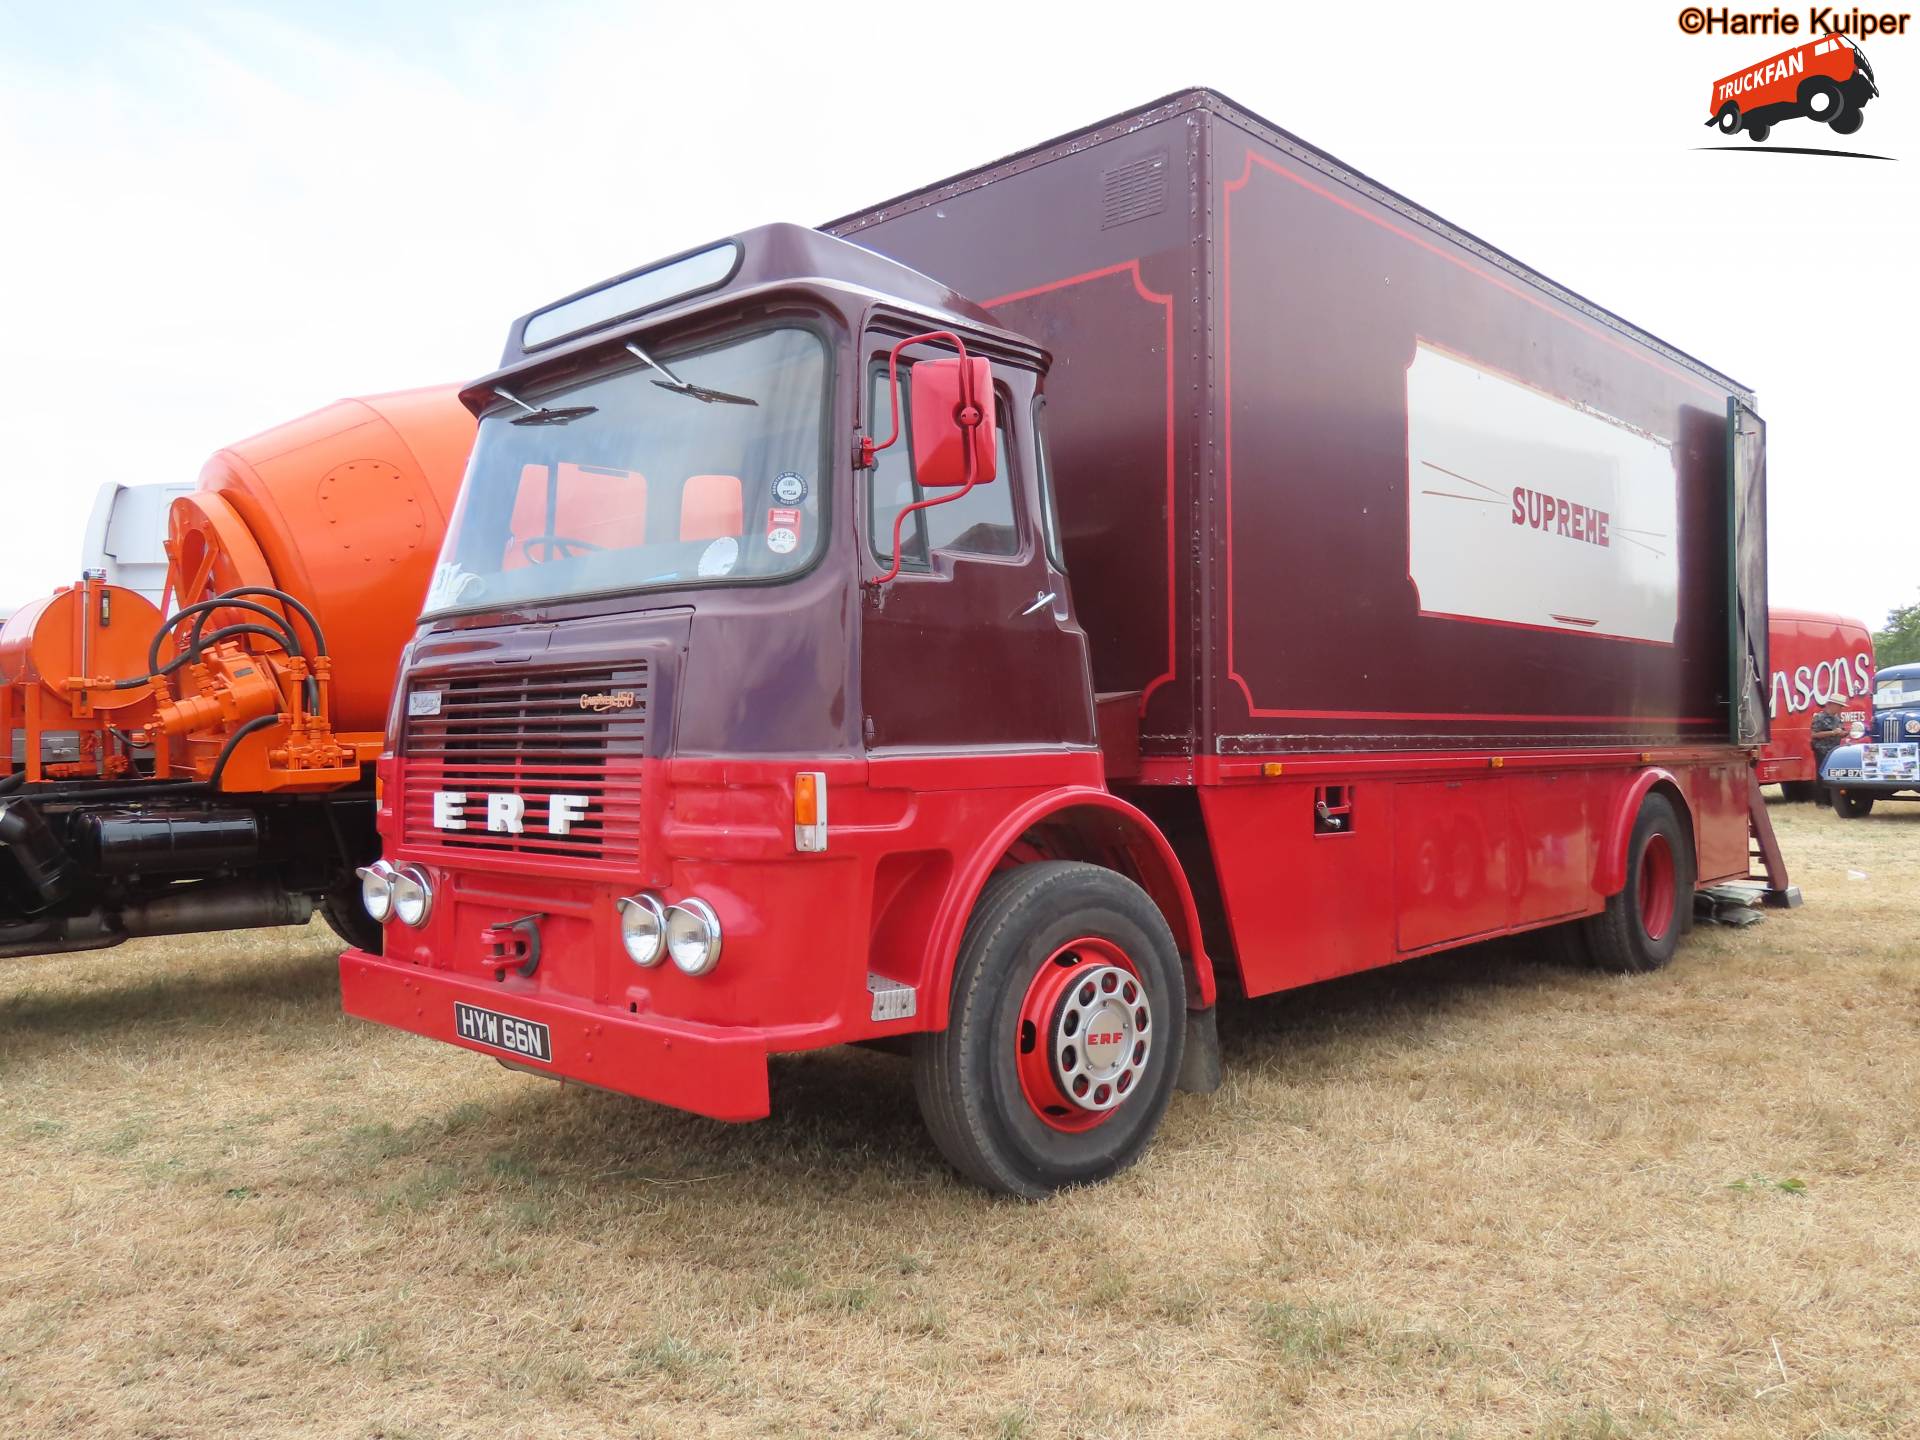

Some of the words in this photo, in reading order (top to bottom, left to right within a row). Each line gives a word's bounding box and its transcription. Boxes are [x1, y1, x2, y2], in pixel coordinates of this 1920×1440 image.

[1512, 486, 1609, 548] SUPREME
[1840, 711, 1865, 722] SWEETS
[433, 791, 589, 835] ERF
[461, 1007, 498, 1044] HYW
[502, 1018, 542, 1057] 66N
[1087, 1032, 1123, 1045] ERF
